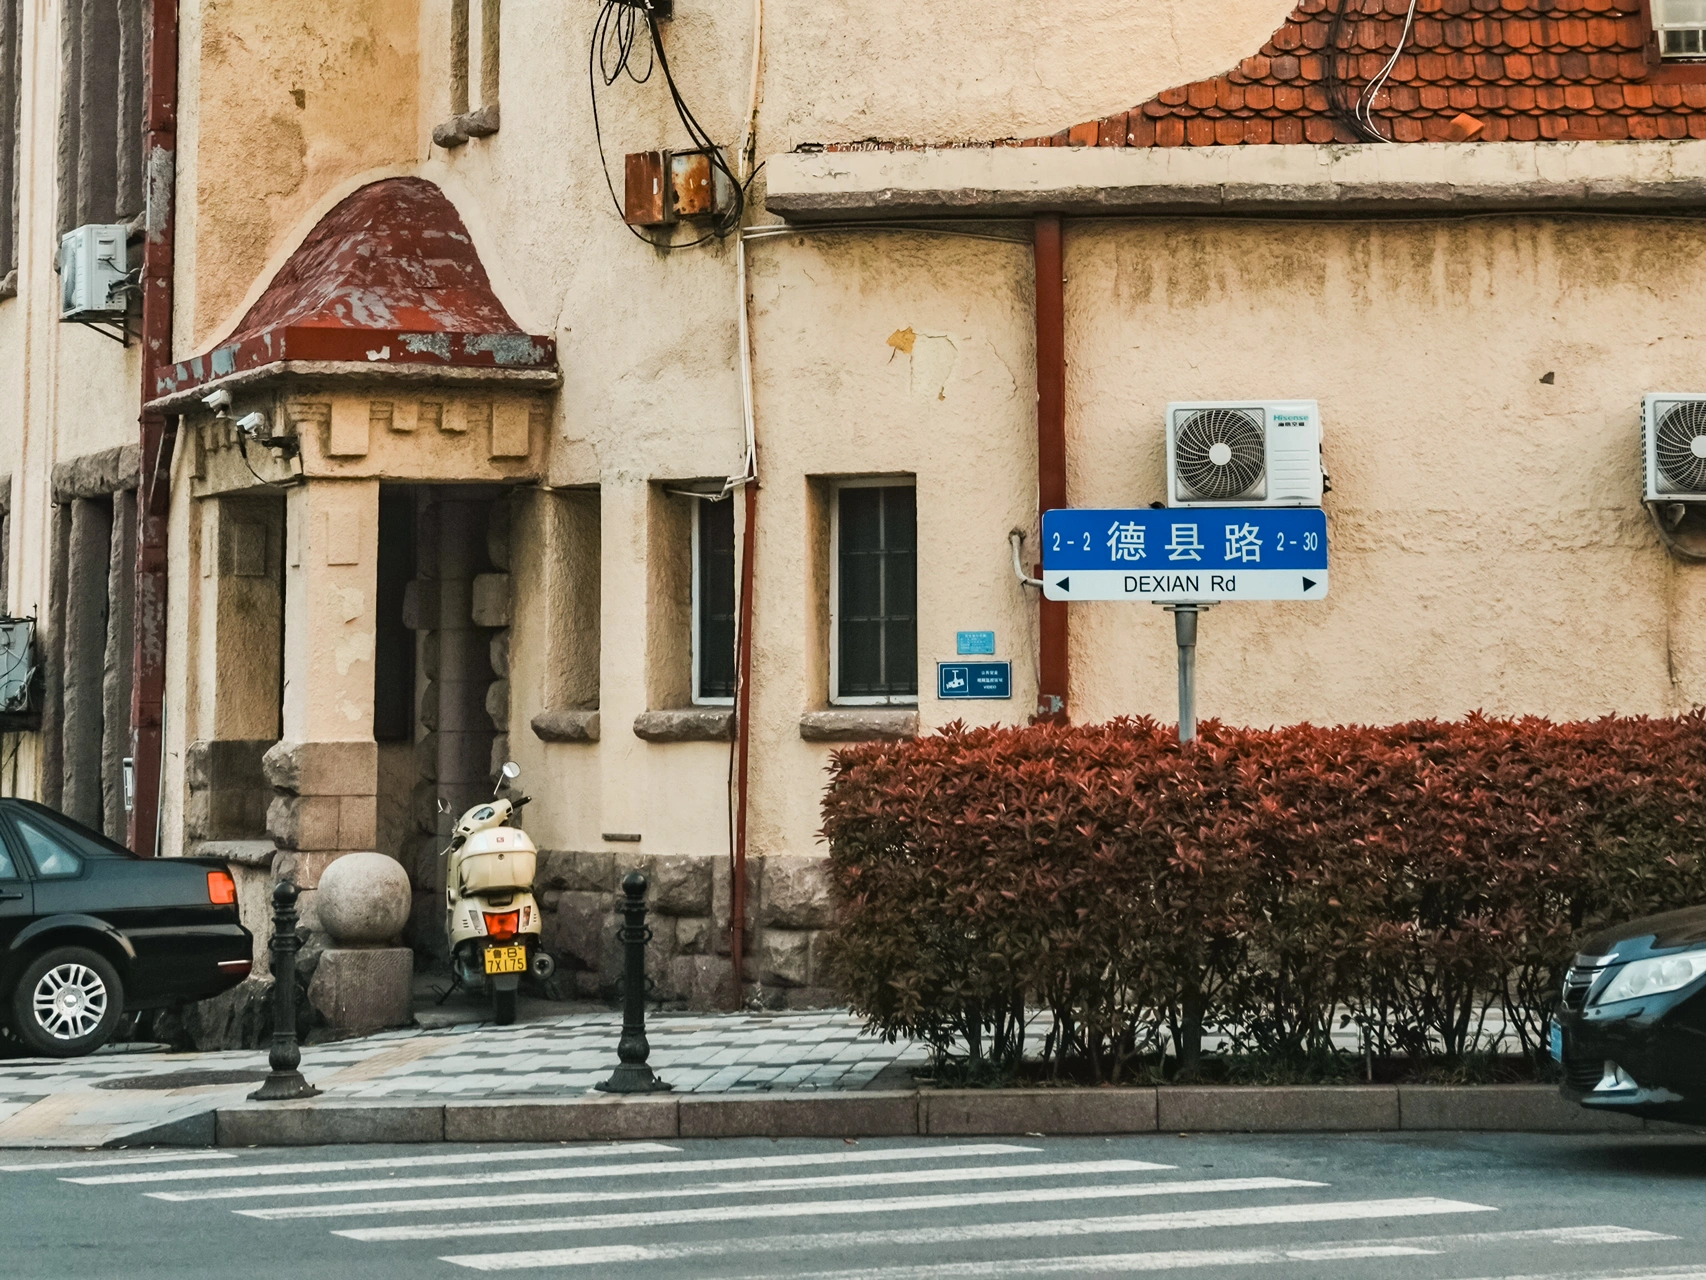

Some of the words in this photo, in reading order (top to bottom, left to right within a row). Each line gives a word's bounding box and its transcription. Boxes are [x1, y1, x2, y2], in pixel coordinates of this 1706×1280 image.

[1106, 521, 1264, 562] 德县路
[1124, 576, 1199, 593] DEXIAN
[1211, 575, 1236, 592] Rd
[487, 958, 524, 972] 7X175
